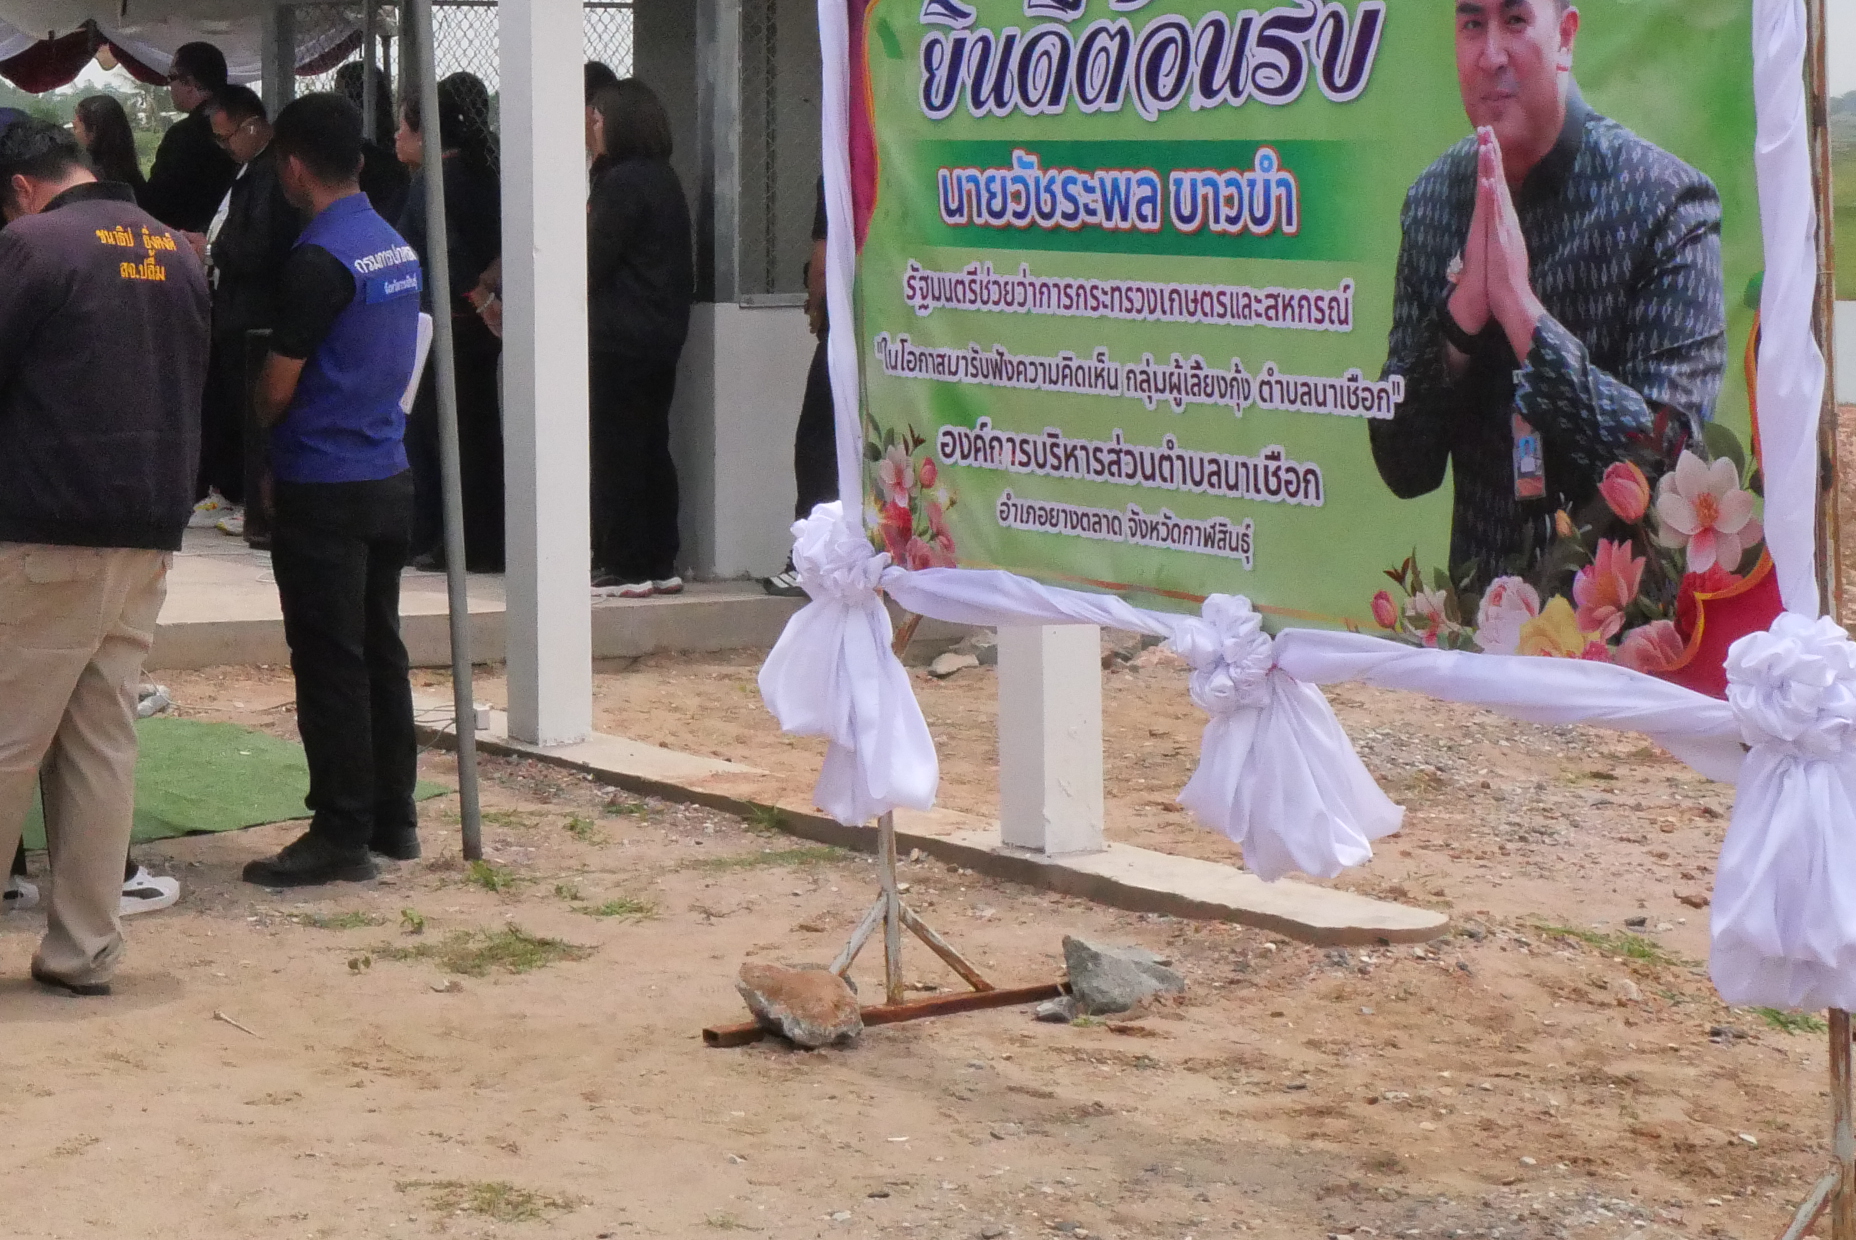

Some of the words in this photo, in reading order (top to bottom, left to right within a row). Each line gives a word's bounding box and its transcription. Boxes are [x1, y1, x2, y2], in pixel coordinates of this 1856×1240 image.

[939, 153, 1159, 231] นายวัชระพล
[1172, 149, 1296, 232] ขาวขำ
[905, 262, 1350, 327] รัฐมนตรีช่วยว่าการกระทรวงเกษตรและสหกรณ์
[1124, 357, 1251, 413] กลุ่มผู้เลี้ยงกุ้ง
[939, 421, 1321, 501] องค์การบริหารส่วนตำบลนาเชือก
[998, 493, 1123, 537] อำเภอยางตลาด
[1128, 508, 1251, 565] จังหวัดกาฬสินธุ์
